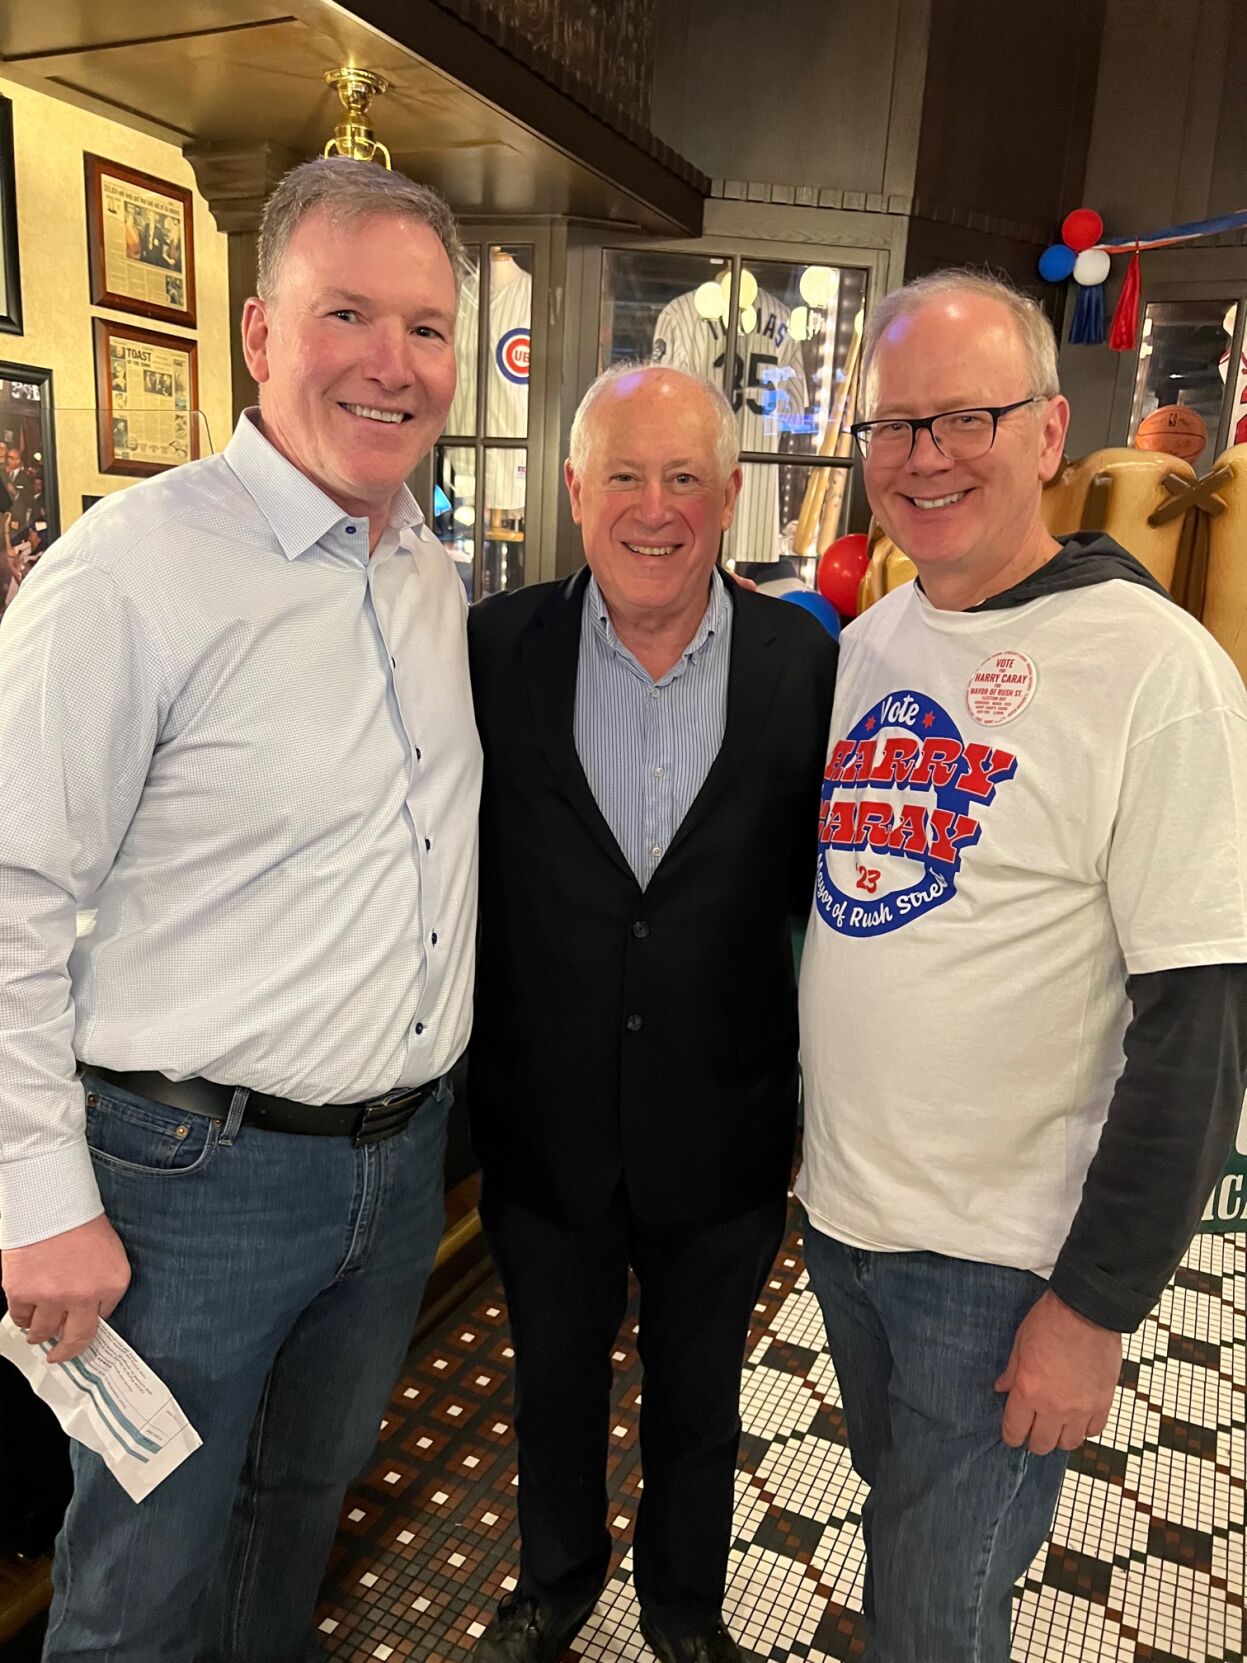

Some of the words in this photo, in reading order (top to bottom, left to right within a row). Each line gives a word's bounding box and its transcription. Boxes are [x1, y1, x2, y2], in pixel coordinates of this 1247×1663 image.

[126, 348, 152, 362] TOAST
[996, 658, 1015, 668] VOTE
[974, 673, 1001, 682] HARRY
[1001, 674, 1028, 684] CARAY
[880, 694, 920, 725] Vote
[824, 737, 1017, 800] HARRY
[832, 901, 848, 927] of
[849, 902, 893, 928] Rush
